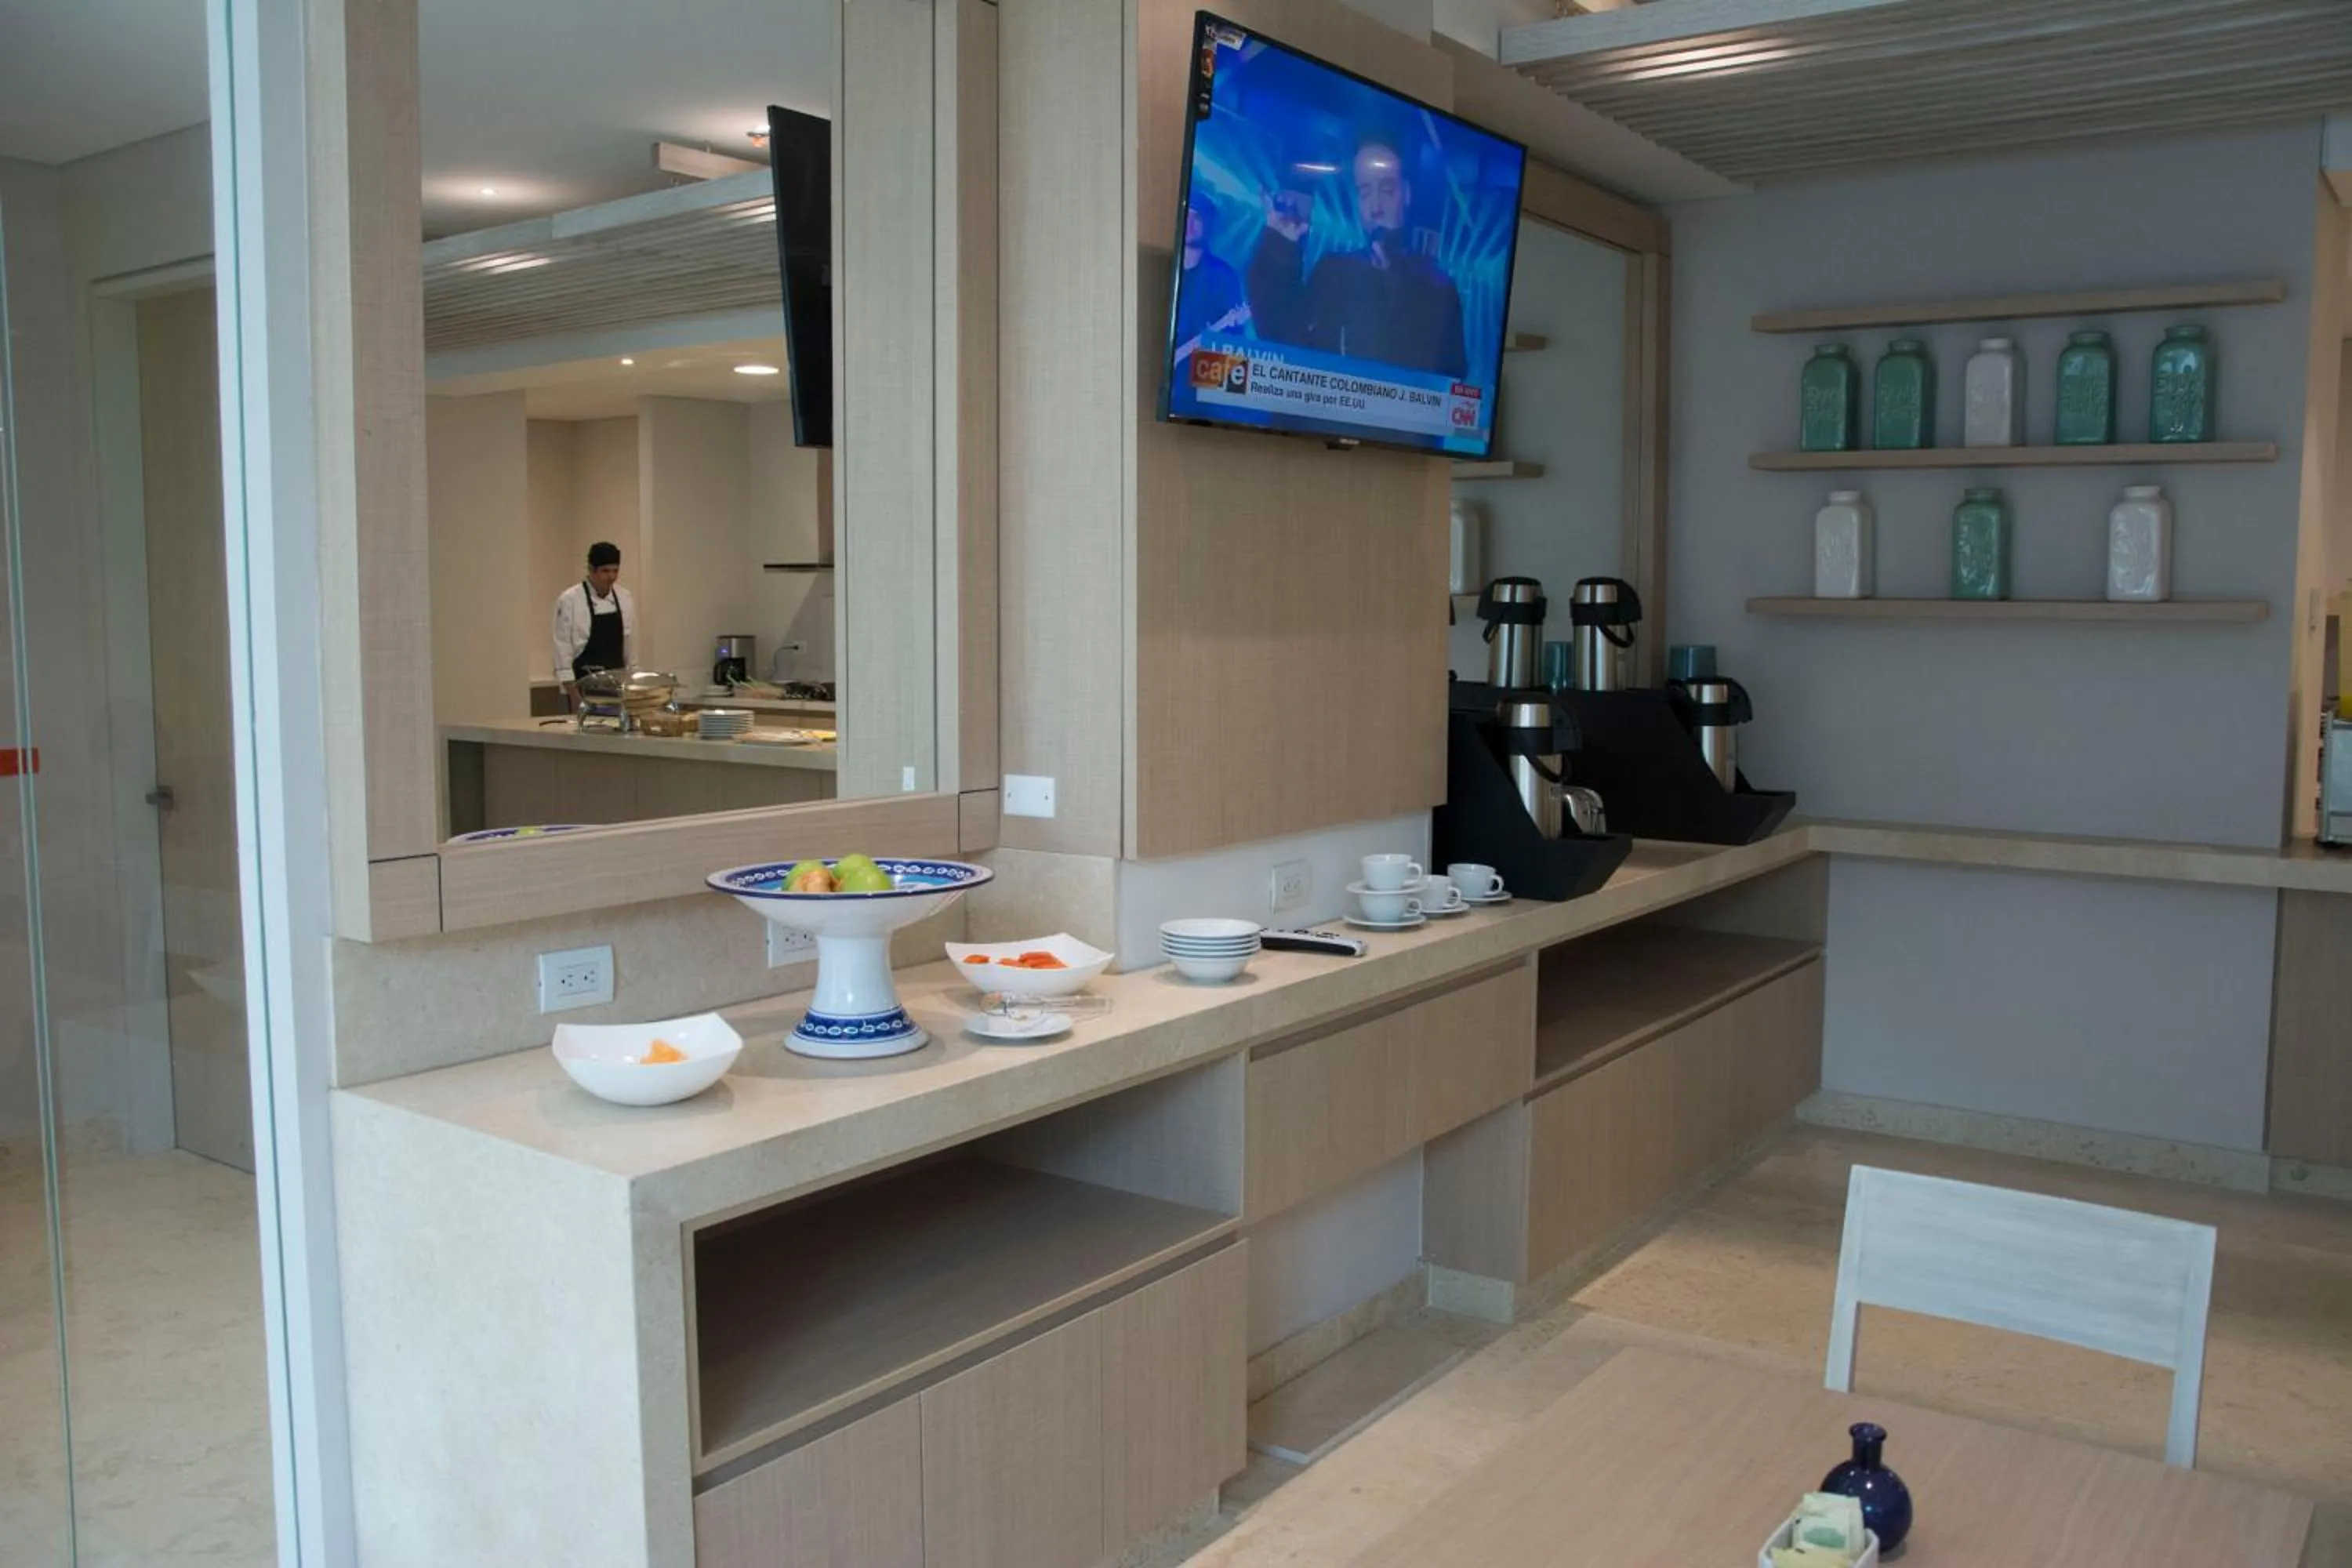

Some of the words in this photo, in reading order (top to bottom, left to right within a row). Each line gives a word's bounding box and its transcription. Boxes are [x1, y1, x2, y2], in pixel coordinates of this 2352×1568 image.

[1250, 381, 1284, 397] Realiza
[1287, 390, 1302, 399] una
[1323, 395, 1338, 406] por
[1252, 363, 1266, 378] EL
[1269, 366, 1328, 388] CANTANTE
[1330, 377, 1397, 399] COLOMBIANO
[1409, 391, 1442, 406] BALVIN
[1452, 407, 1477, 426] CNN
